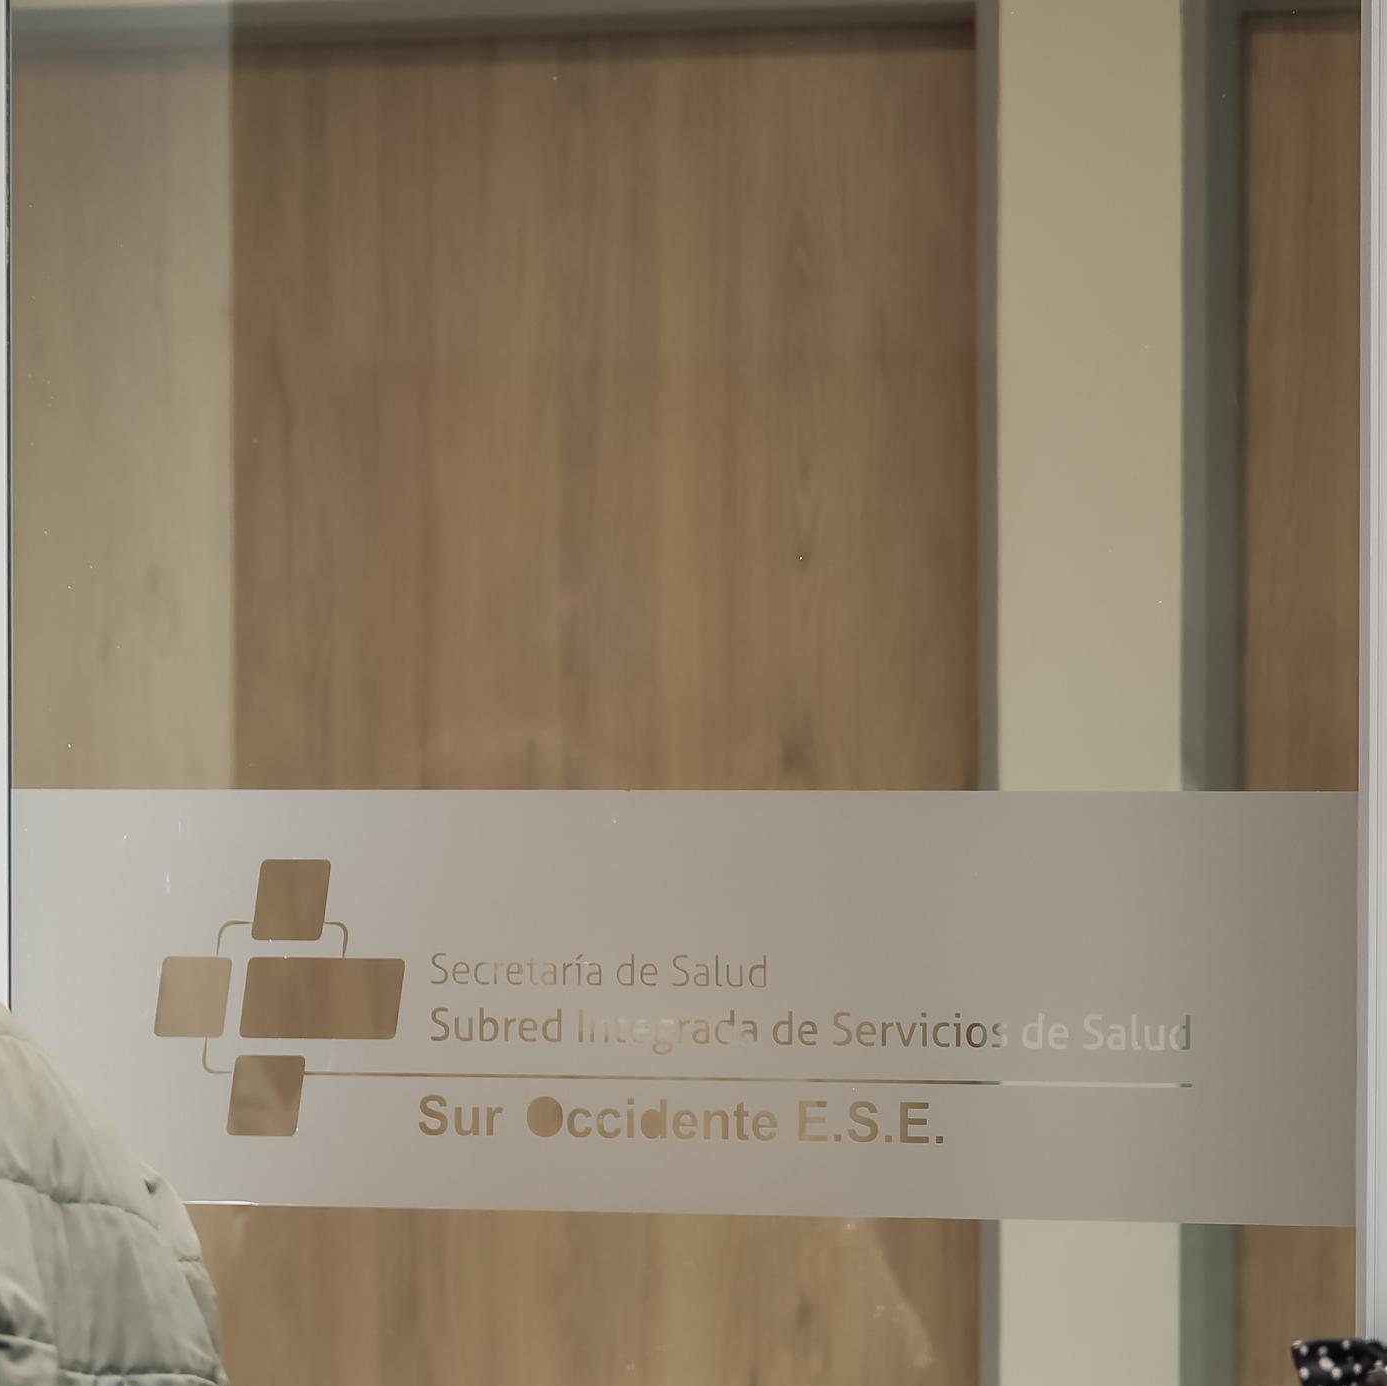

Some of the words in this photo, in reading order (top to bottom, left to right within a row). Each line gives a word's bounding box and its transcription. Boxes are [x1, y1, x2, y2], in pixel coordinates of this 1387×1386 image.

[430, 952, 603, 988] Secretaría
[615, 953, 659, 988] de
[671, 954, 768, 989] Salud
[430, 1006, 563, 1043] Subred
[577, 1008, 758, 1056] Integrada
[772, 1010, 819, 1047] de
[832, 1011, 1009, 1049] Servicios
[1021, 1013, 1070, 1051] de
[1081, 1013, 1192, 1052] Salud
[418, 1094, 503, 1137] Sur
[527, 1096, 778, 1142] Occidente
[798, 1100, 944, 1145] E.S.E.
